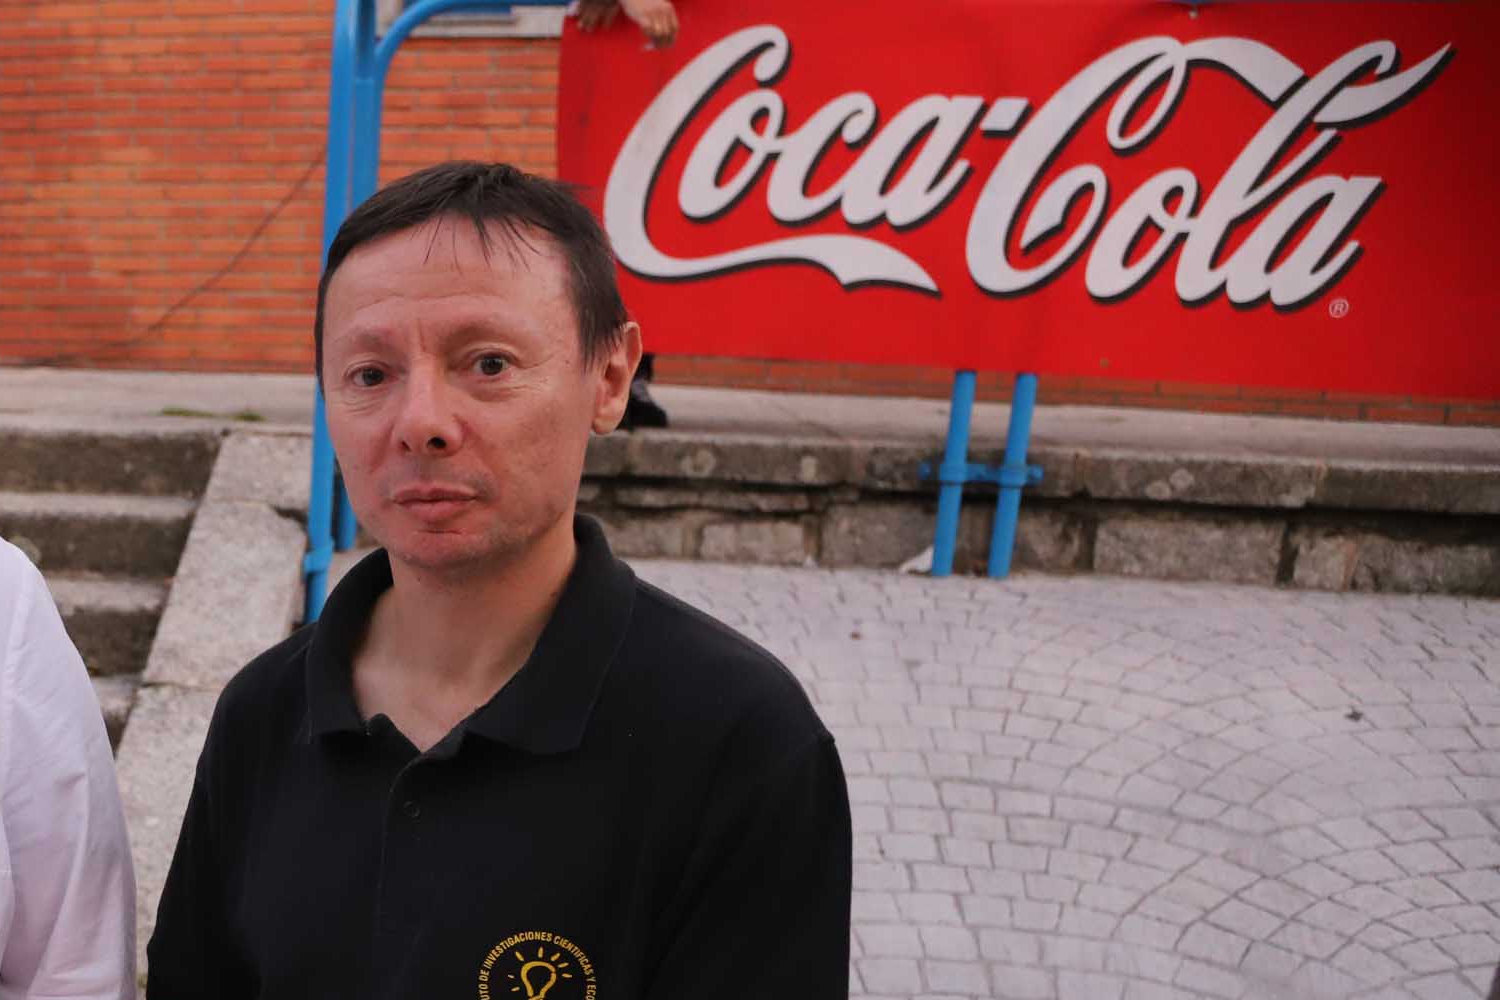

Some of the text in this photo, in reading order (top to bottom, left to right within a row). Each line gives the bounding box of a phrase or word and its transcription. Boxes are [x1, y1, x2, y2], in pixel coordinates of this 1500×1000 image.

[603, 24, 1455, 312] Coca-Cola
[483, 931, 553, 970] INVESTIGACIONES
[478, 969, 489, 982] DE
